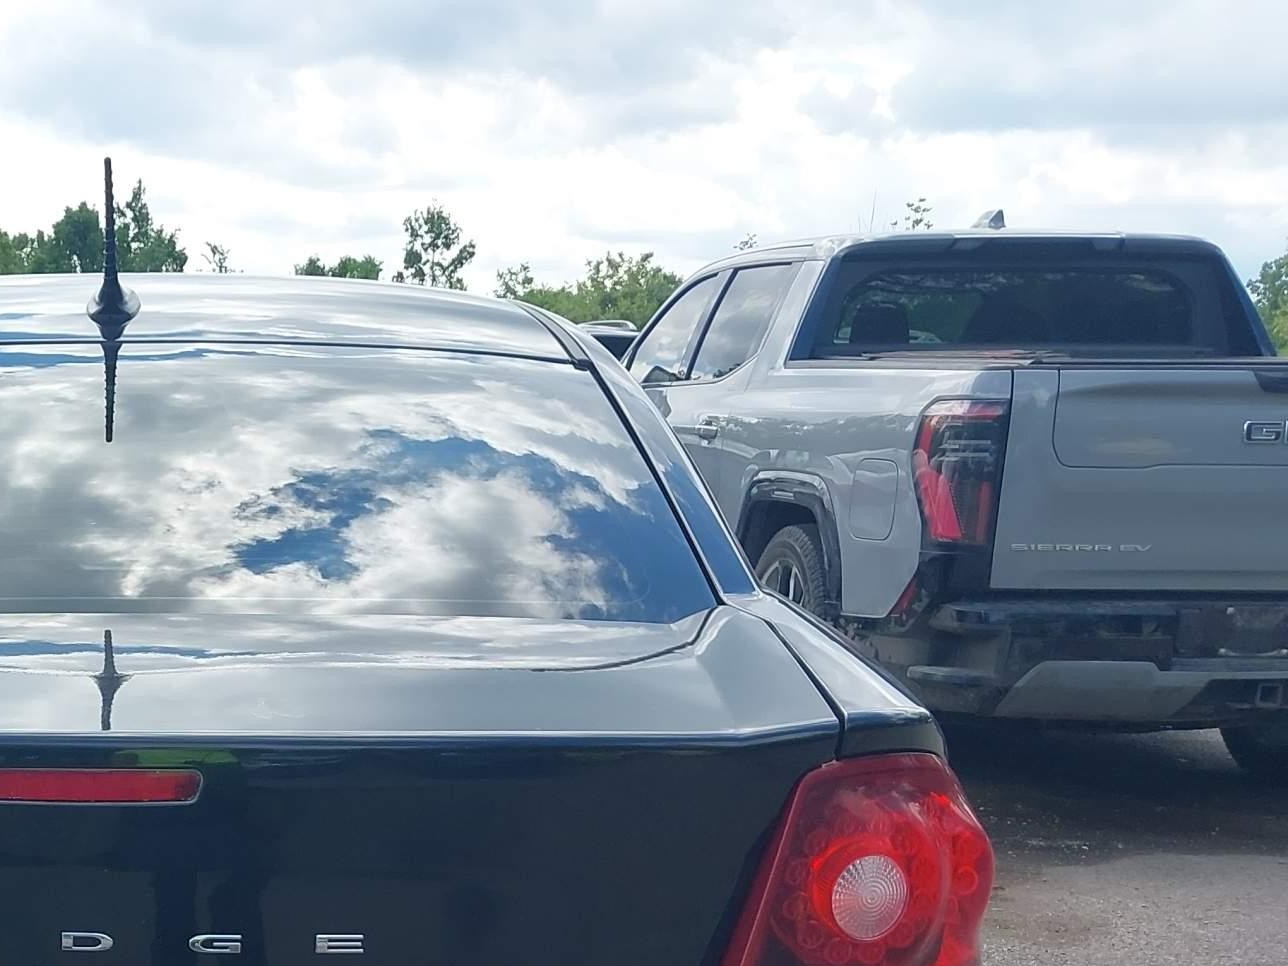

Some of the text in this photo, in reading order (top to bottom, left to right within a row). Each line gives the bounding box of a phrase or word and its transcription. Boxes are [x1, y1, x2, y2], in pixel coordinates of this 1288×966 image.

[1243, 420, 1288, 443] G
[1010, 543, 1153, 552] SIERRA EV
